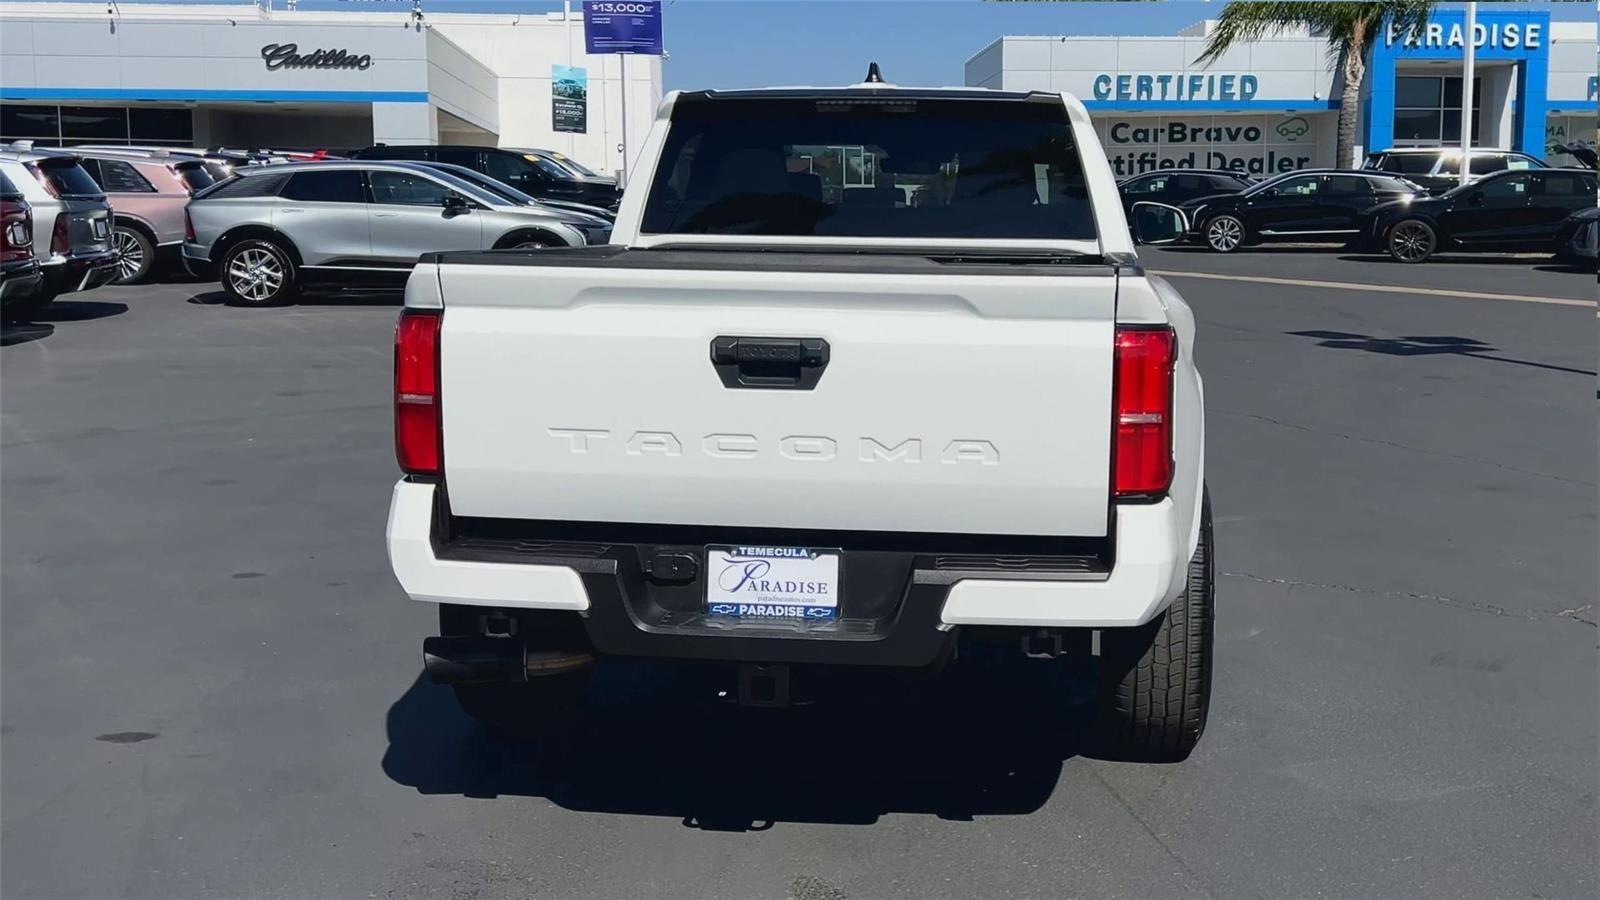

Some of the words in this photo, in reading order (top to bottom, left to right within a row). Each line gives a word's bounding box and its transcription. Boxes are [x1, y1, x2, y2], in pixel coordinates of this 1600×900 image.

[592, 3, 646, 13] $13,000
[1386, 23, 1541, 48] PARADISE
[261, 43, 371, 71] Cadillac
[1093, 74, 1258, 101] CERTIFIED
[1111, 122, 1261, 144] CarBravo
[1108, 152, 1194, 176] tified
[1207, 150, 1311, 174] Dealer
[547, 427, 1001, 466] TACOMA
[739, 547, 808, 557] TEMECULA
[718, 557, 828, 595] PARADISE
[739, 605, 805, 616] PARADISE
[757, 595, 816, 603] paradiseautos.com
